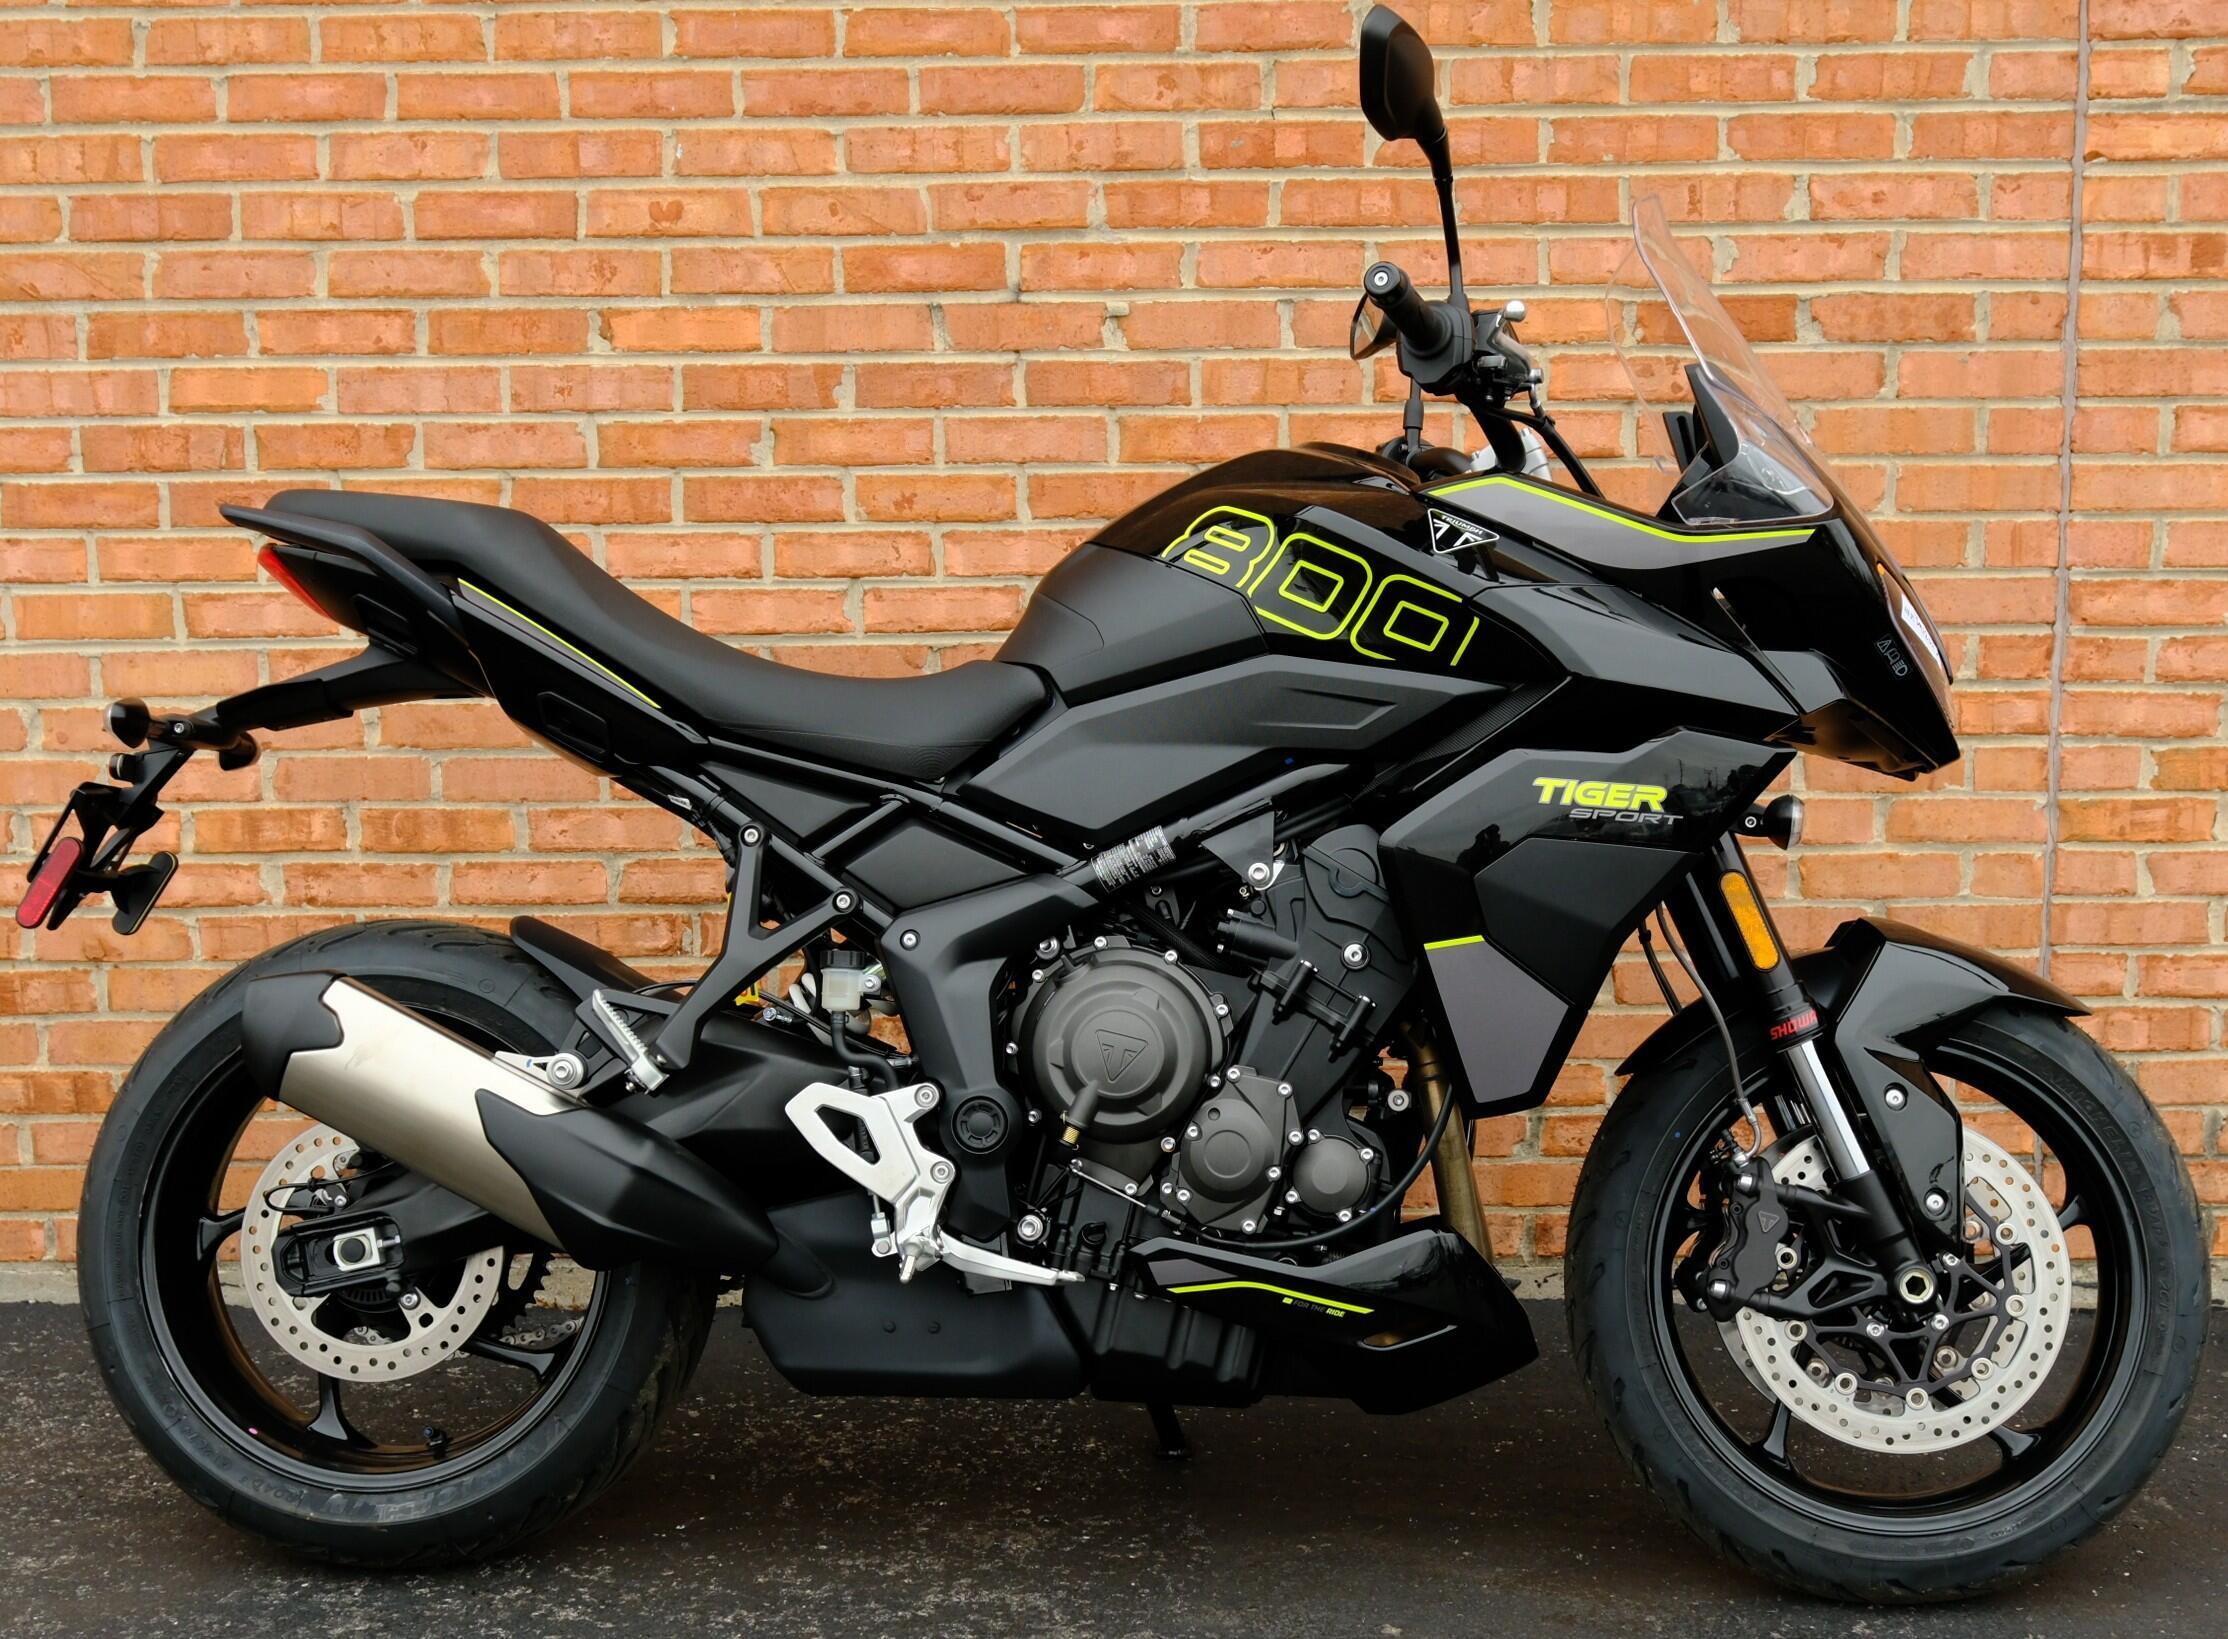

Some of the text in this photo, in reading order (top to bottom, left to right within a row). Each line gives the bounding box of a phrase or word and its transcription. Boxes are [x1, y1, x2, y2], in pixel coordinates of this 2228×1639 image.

[1441, 514, 1484, 535] TRIUMPH
[1532, 776, 1669, 813] TIGER
[1568, 807, 1684, 825] SPORT
[1293, 1299, 1346, 1318] FOR THE RIDE
